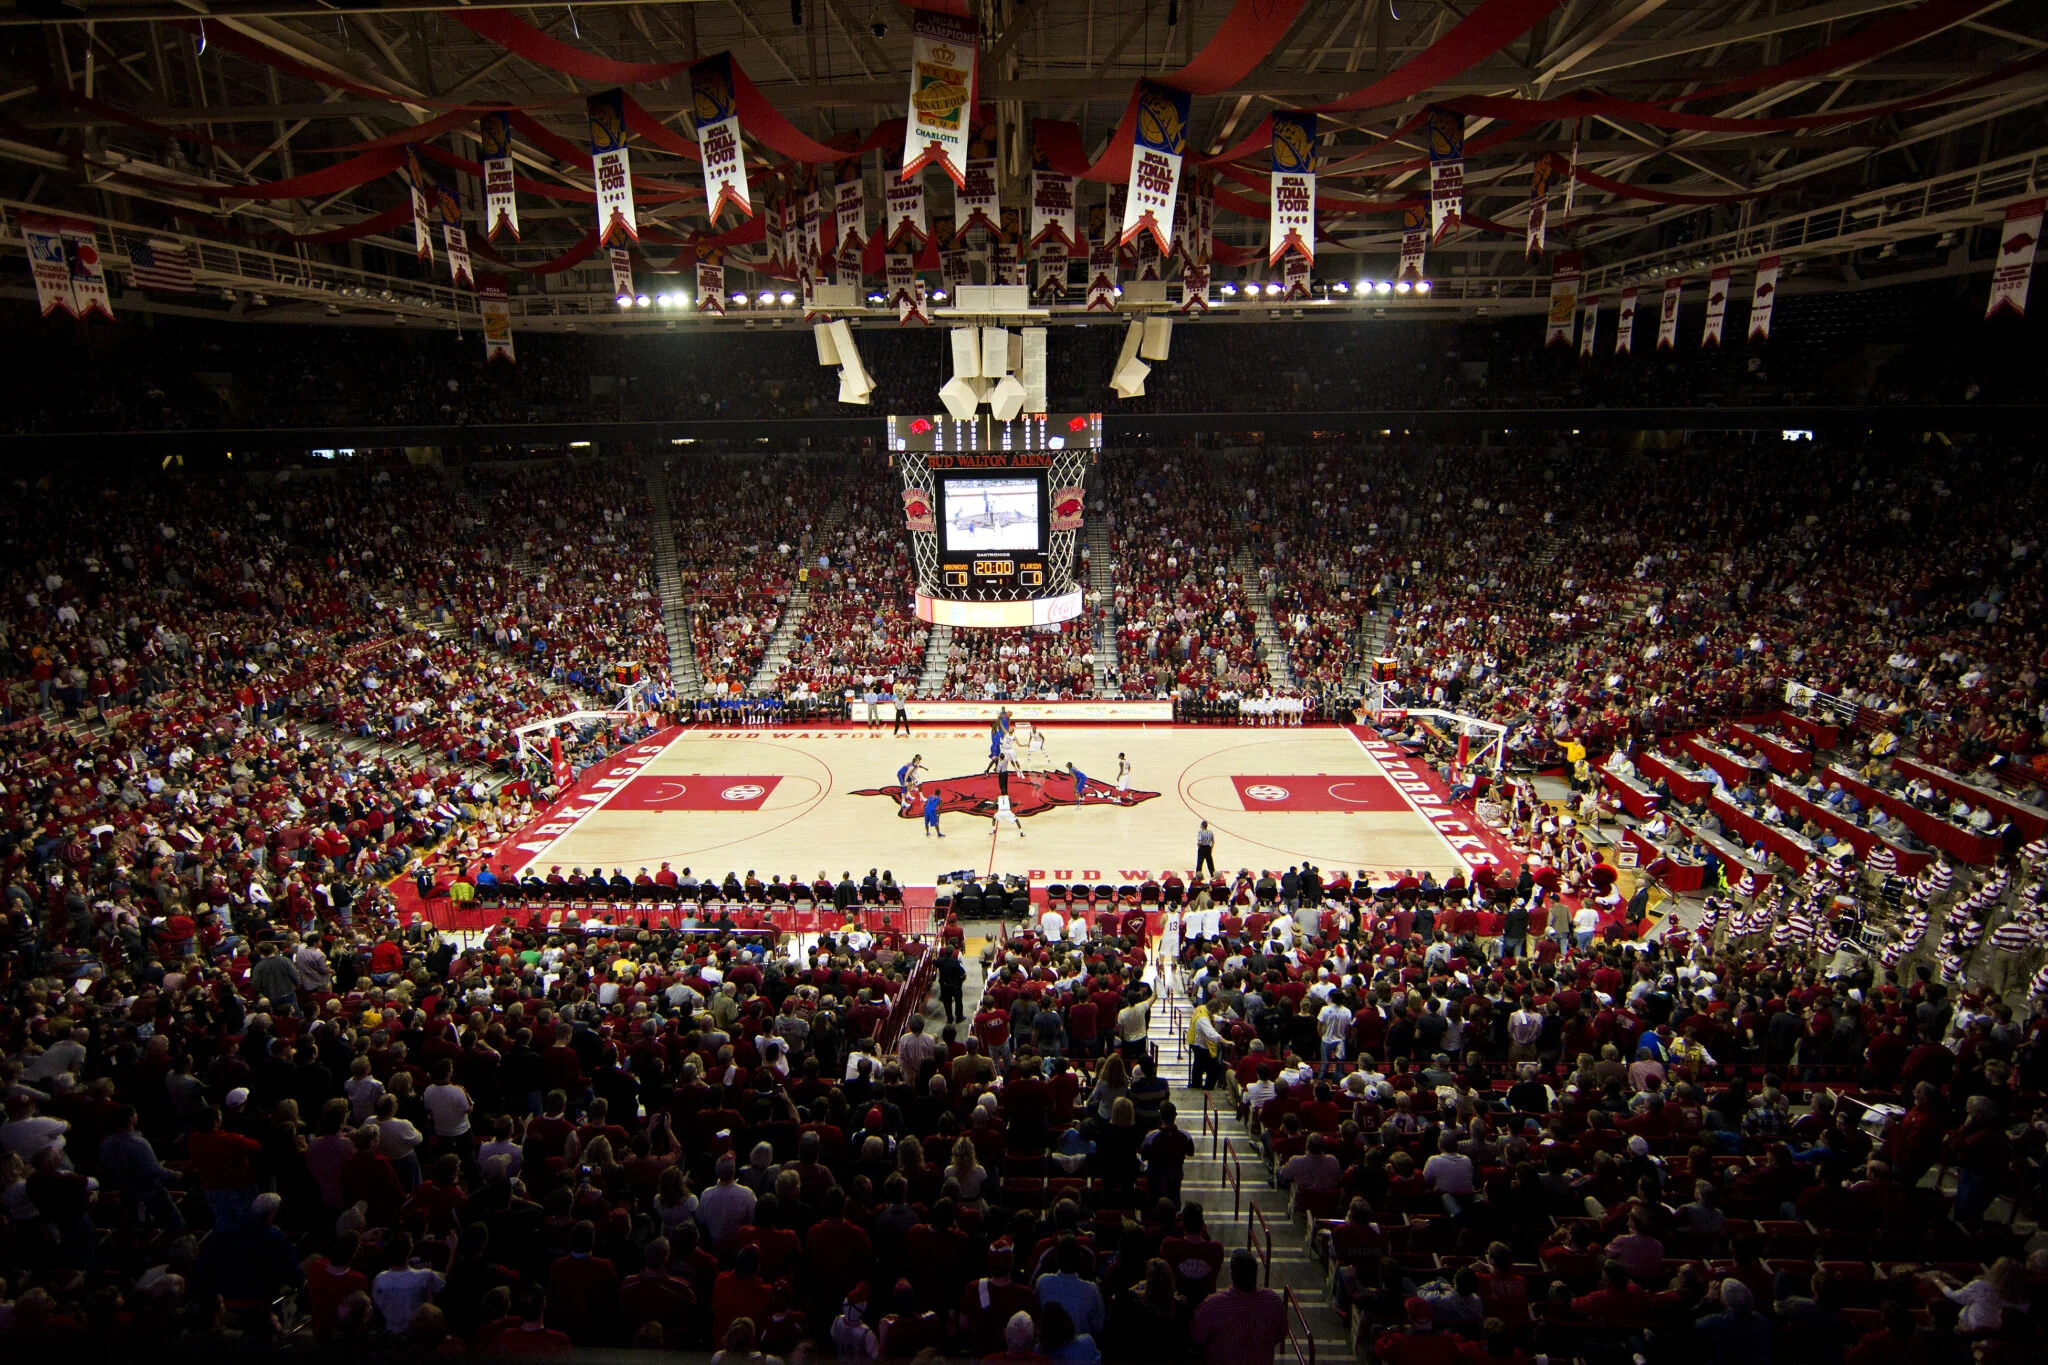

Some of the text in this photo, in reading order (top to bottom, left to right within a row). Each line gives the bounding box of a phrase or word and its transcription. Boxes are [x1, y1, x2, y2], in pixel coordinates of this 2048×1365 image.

[915, 23, 976, 43] CHAMPIONS
[917, 96, 966, 111] FINAL FOUR
[919, 115, 959, 130] 1994
[707, 124, 729, 139] NCAA
[915, 128, 959, 144] CHARLOTTE
[704, 133, 736, 155] FINAL
[601, 154, 619, 166] NCAA
[708, 149, 736, 167] FOUR
[1144, 151, 1169, 168] NCAA
[598, 163, 625, 180] FINAL
[710, 164, 737, 180] 1990
[1137, 160, 1174, 183] FINAL
[602, 176, 625, 192] FOUR
[1137, 174, 1171, 195] FOUR
[1282, 177, 1305, 186] NCAA
[887, 185, 923, 200] CHAMPS
[1137, 192, 1166, 207] 1978
[1276, 187, 1311, 199] FINAL
[836, 196, 863, 213] CHAMPS
[892, 200, 918, 212] 1926
[1278, 199, 1309, 212] FOUR
[928, 453, 1053, 468] BUD WALTON ARENA
[976, 561, 1012, 574] 20:00
[1020, 562, 1043, 570] FLORIDA
[958, 572, 967, 585] 0
[1033, 571, 1042, 584] 0
[1382, 662, 1397, 671] 20:00
[1383, 670, 1395, 681] 35
[515, 745, 664, 853] ARKANSAS
[1247, 785, 1287, 800] SEC
[1361, 740, 1500, 865] RAZORBACKS
[1028, 870, 1101, 880] BUD
[1169, 921, 1179, 931] 13
[1362, 1116, 1376, 1128] 15
